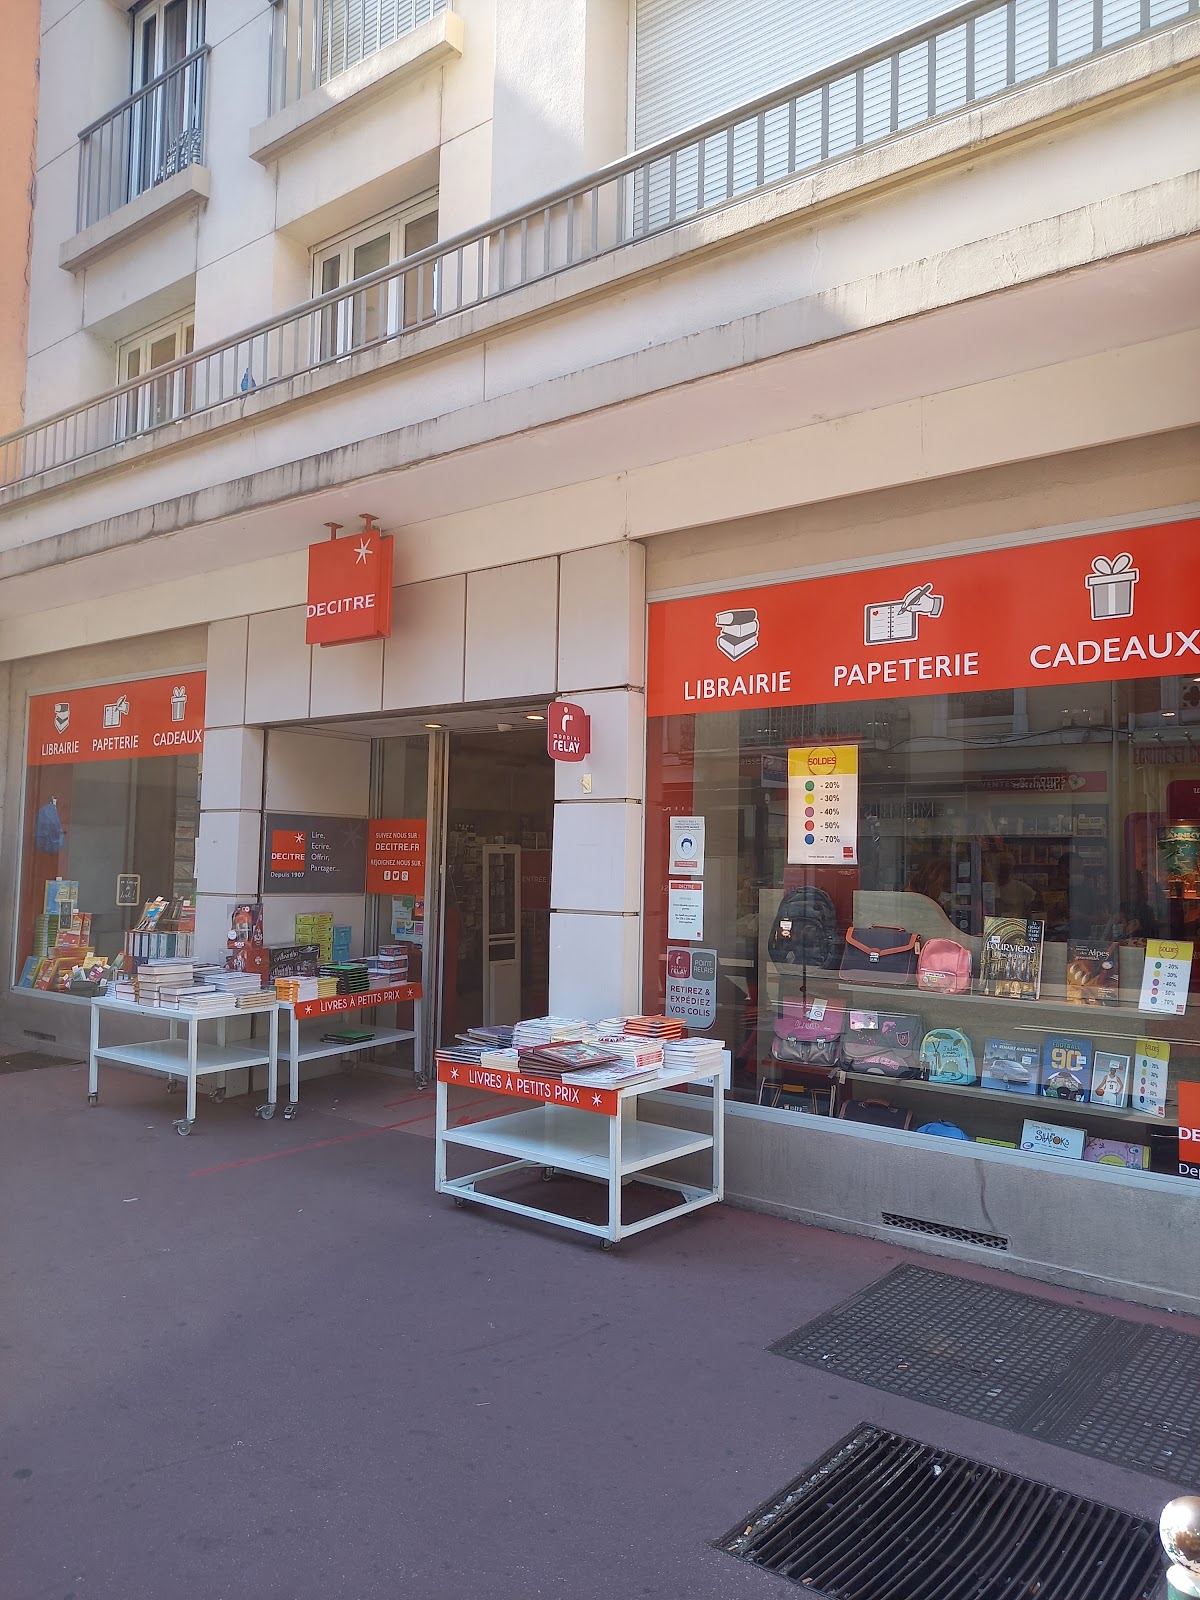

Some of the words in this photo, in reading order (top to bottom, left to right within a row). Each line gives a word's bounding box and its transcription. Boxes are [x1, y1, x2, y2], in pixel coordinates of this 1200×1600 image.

[306, 593, 376, 618] DECITRE
[1029, 629, 1200, 669] CADEAUX
[833, 651, 979, 687] PAPETERIE
[684, 671, 792, 701] LIBRAIRIE
[152, 729, 203, 746] CADEAUX
[41, 740, 80, 756] LIBRAIRIE
[92, 735, 139, 752] PAPETERIE
[808, 756, 837, 766] SOLDES
[311, 831, 326, 840] Lire,
[824, 835, 840, 843] 70%
[311, 843, 332, 851] Ecrire,
[375, 842, 420, 852] DECITRE.FR
[271, 852, 306, 861] DECITRE
[311, 853, 330, 862] Offrir,
[370, 859, 396, 867] REJOIGNEZ
[396, 859, 411, 867] NOUS
[270, 871, 290, 879] Depuis
[694, 966, 714, 974] RELAIS
[671, 985, 703, 995] RETIREZ
[705, 988, 710, 996] &
[320, 998, 348, 1012] LIVRES
[350, 995, 356, 1007] À
[357, 992, 382, 1006] PETITS
[383, 989, 400, 1001] PRIX
[671, 995, 710, 1006] EXPÉDIEZ
[670, 1005, 685, 1013] VOS
[688, 1008, 710, 1016] COLIS
[1051, 1048, 1082, 1071] 90
[468, 1069, 502, 1088] LIVRES
[505, 1072, 513, 1090] À
[516, 1078, 552, 1098] PETITS
[554, 1085, 580, 1103] PRIX
[1178, 1127, 1200, 1142] DE
[1178, 1163, 1200, 1179] De
